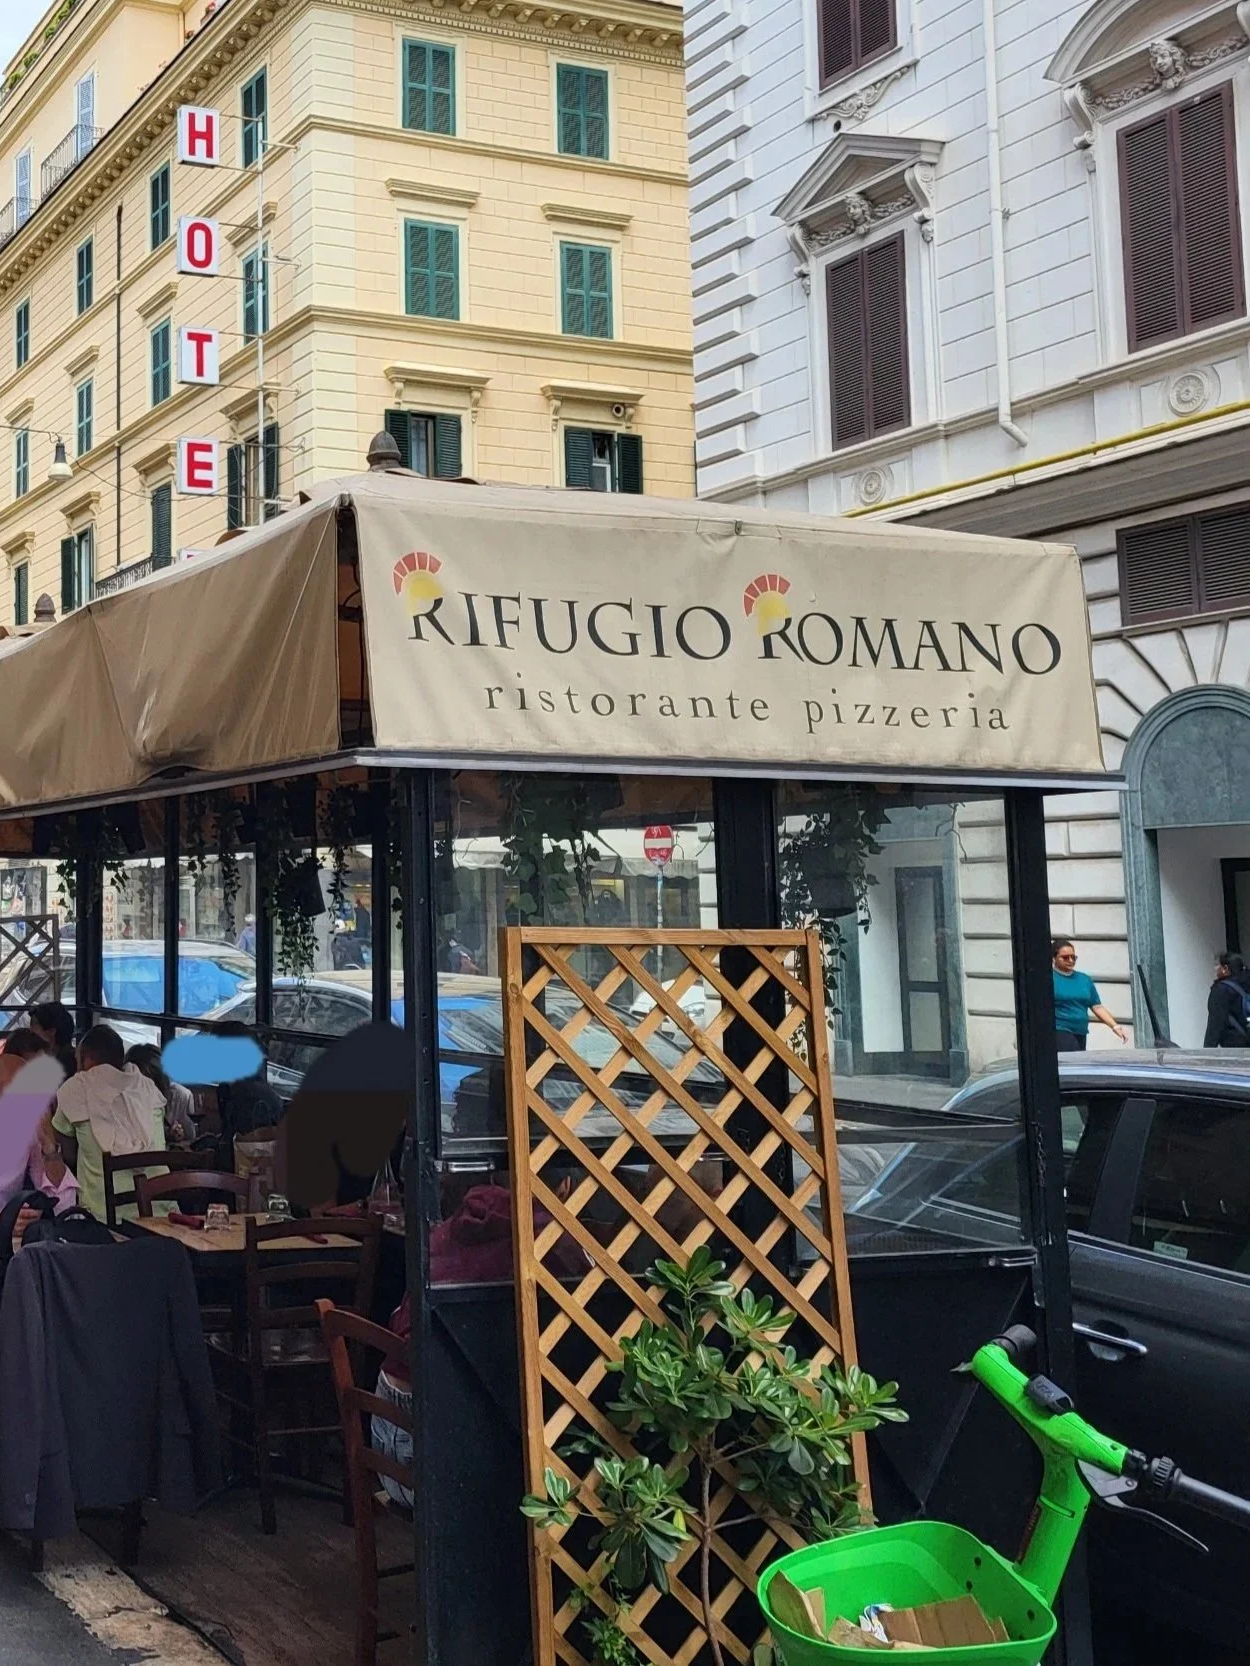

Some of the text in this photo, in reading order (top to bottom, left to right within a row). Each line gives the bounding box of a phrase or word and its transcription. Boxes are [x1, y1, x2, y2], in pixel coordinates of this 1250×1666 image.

[186, 112, 214, 559] HOTE
[407, 590, 1061, 675] RIFUGIO ROMANO
[484, 671, 1010, 734] ristorante pizzeria
